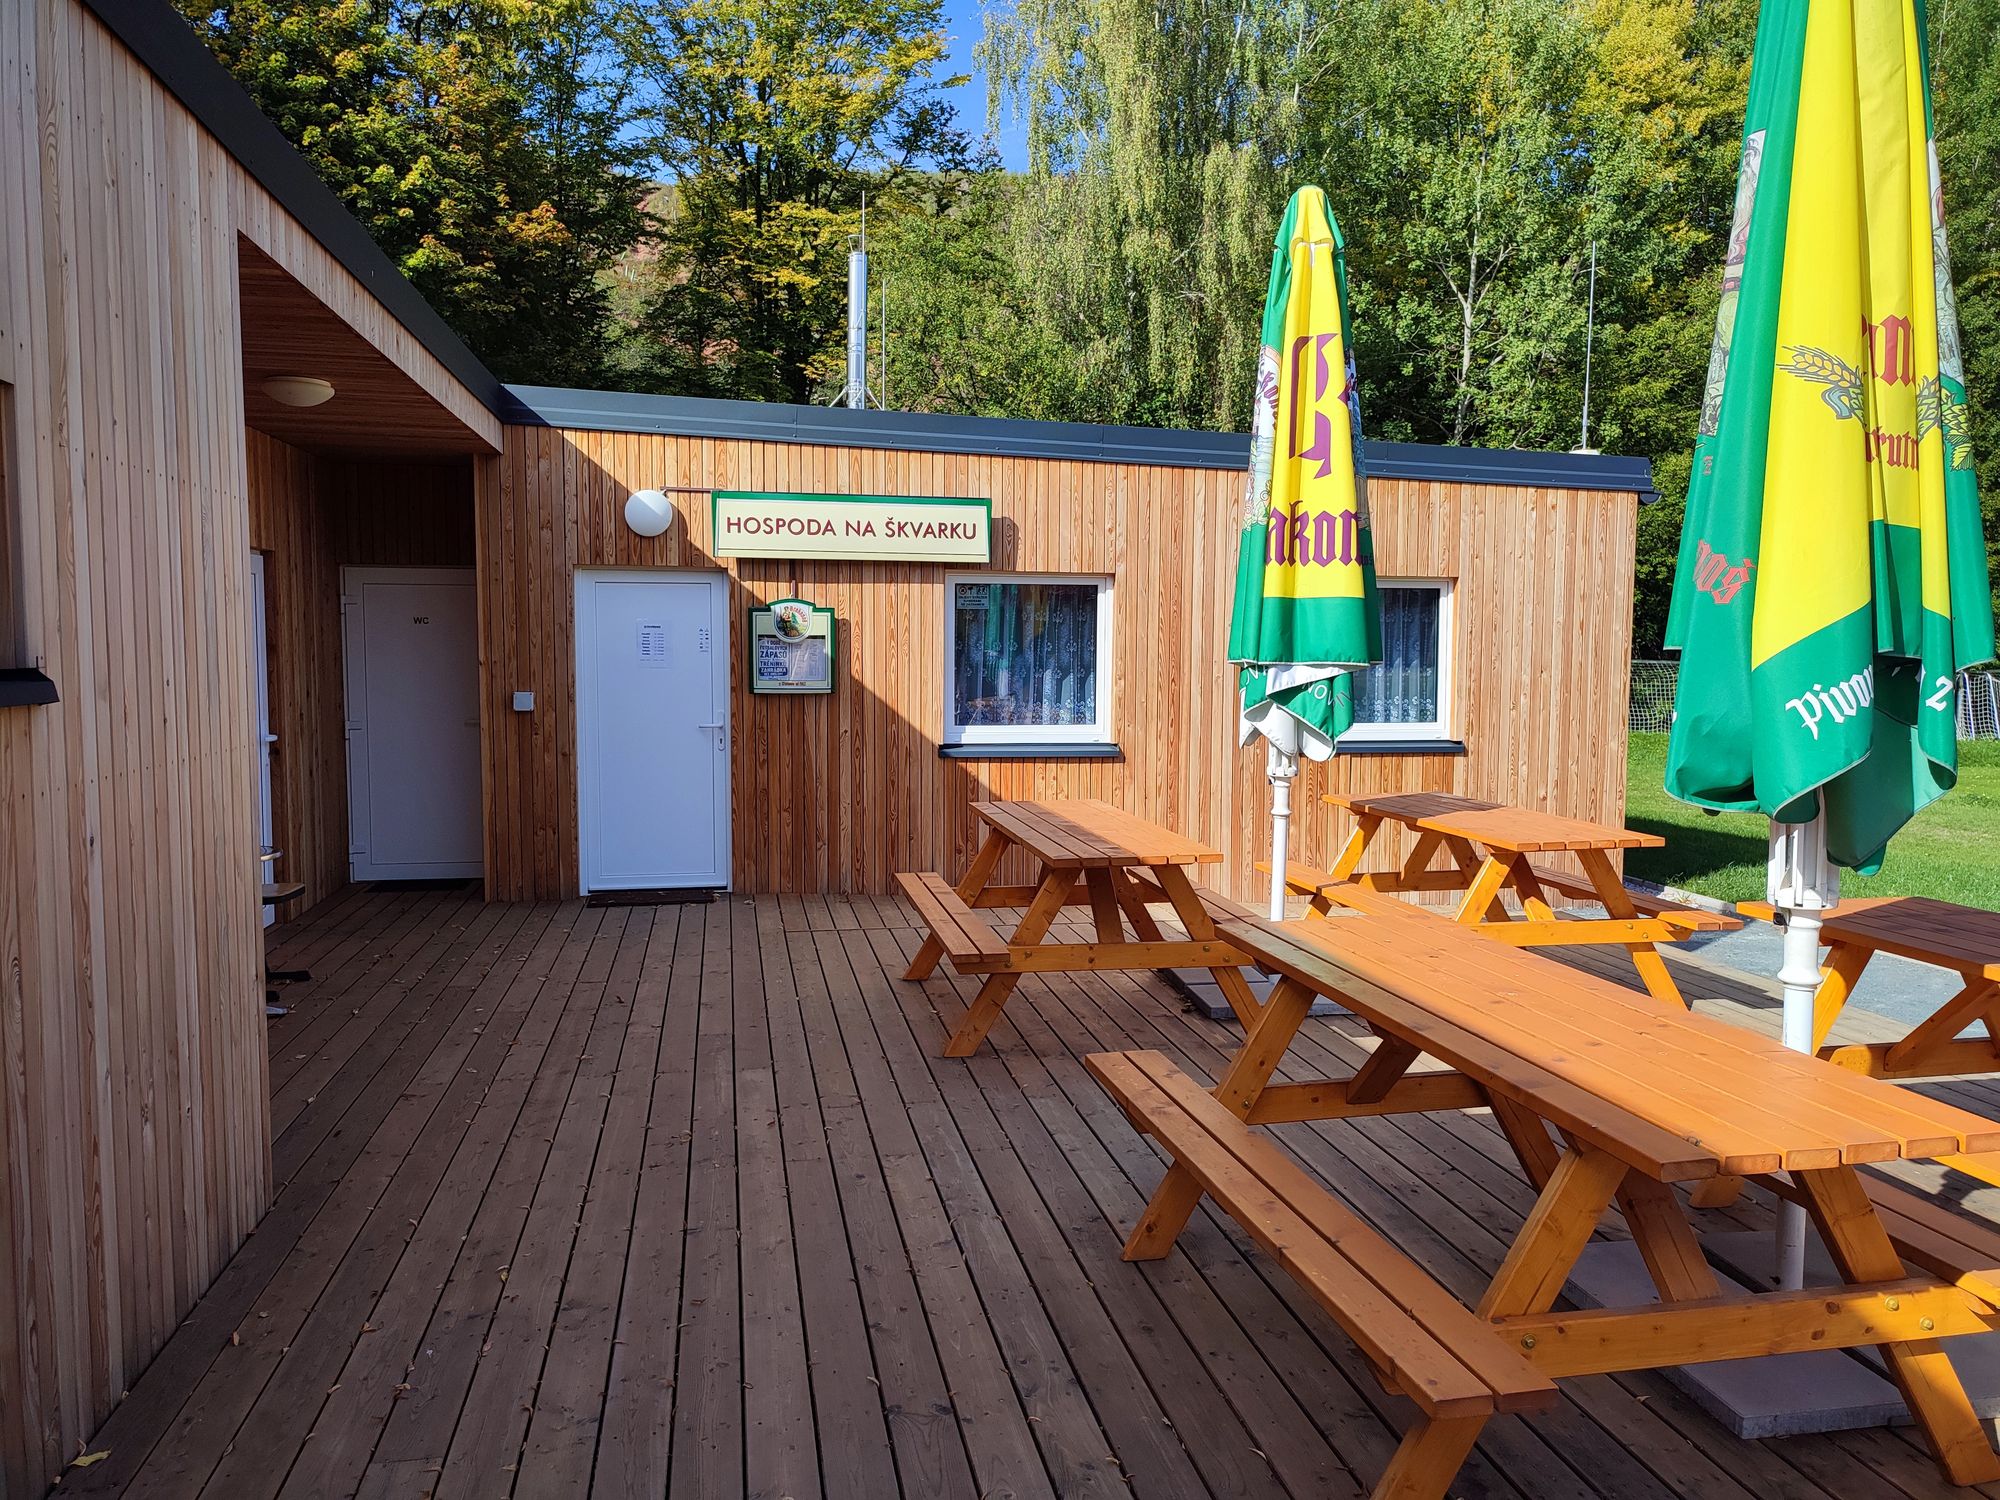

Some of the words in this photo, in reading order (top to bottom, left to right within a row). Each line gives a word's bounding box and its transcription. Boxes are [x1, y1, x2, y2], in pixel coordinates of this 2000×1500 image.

[726, 516, 837, 537] HOSPODA
[845, 519, 877, 538] NA
[884, 516, 978, 540] ŠKVARKU
[413, 616, 430, 625] WC
